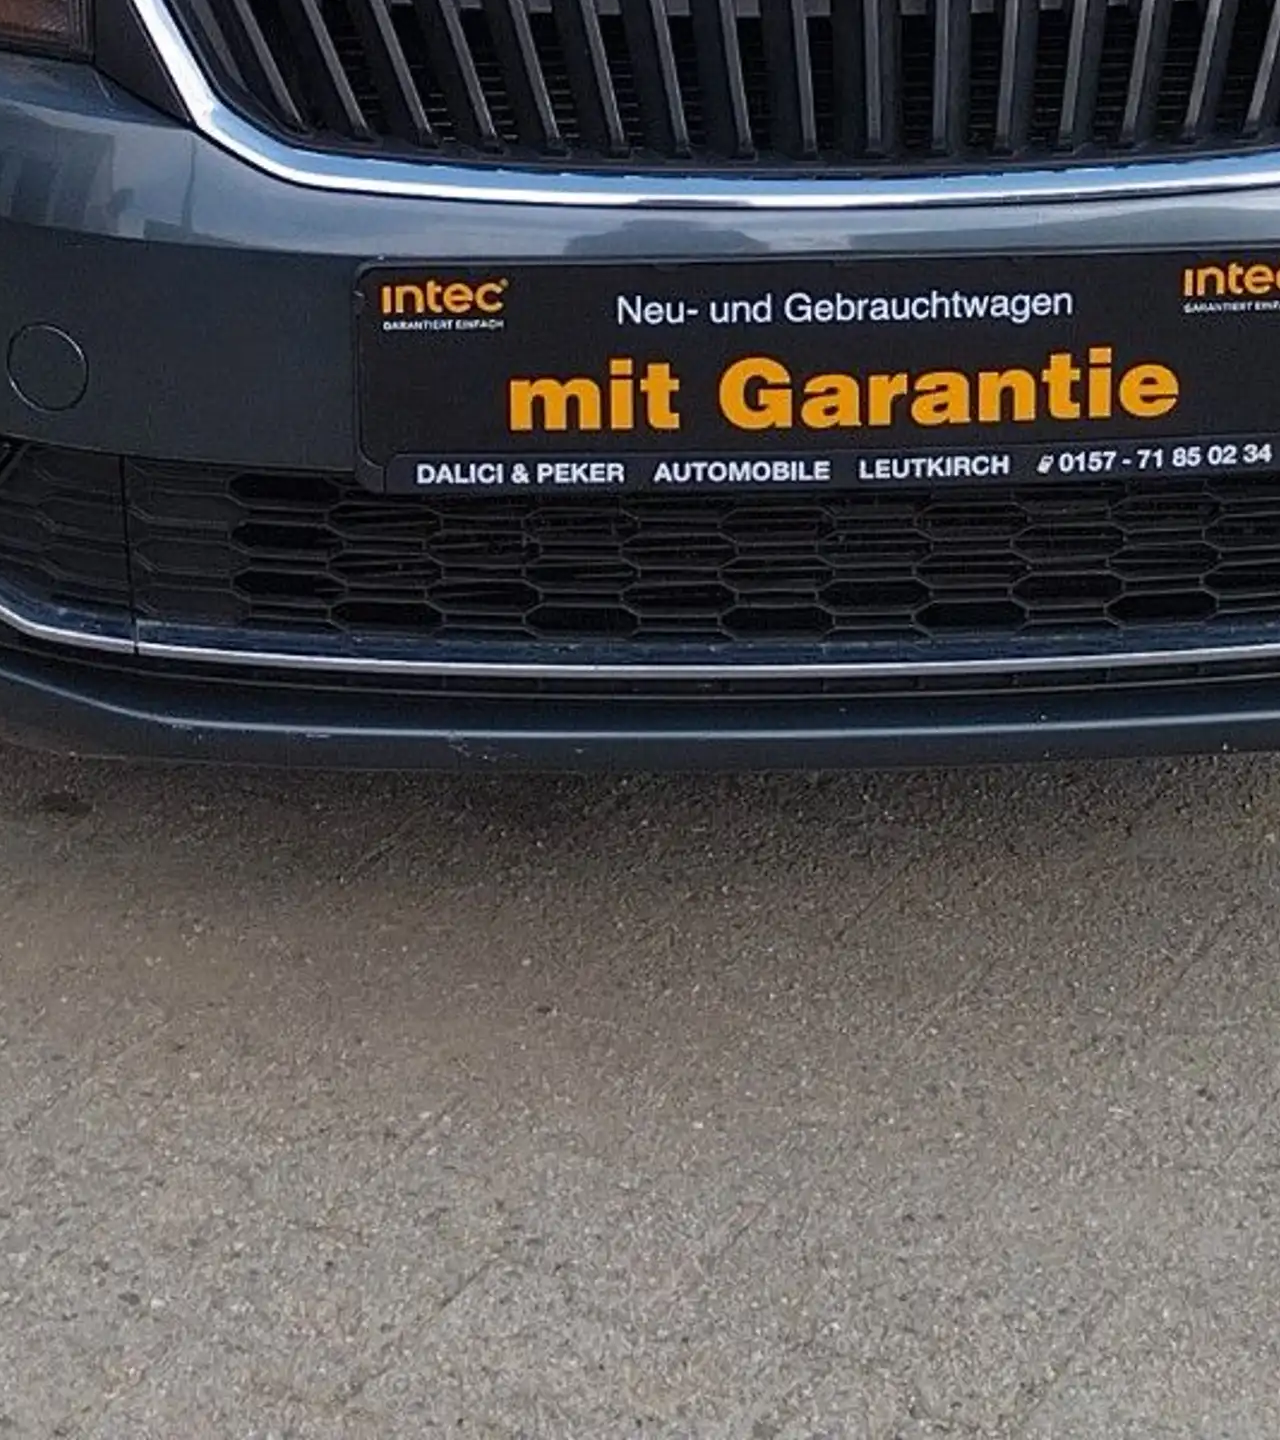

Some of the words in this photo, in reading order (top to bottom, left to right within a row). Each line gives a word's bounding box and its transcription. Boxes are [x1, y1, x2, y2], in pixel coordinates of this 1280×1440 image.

[616, 294, 698, 325] Neu-
[709, 293, 772, 324] und
[783, 290, 1074, 323] Gebrauchtwagen
[509, 358, 681, 431] mit
[719, 347, 1180, 431] Garantie
[416, 463, 504, 485] DALICI
[511, 463, 529, 484] &
[536, 462, 626, 483] PEKER
[653, 460, 831, 483] AUTOMOBILE
[858, 454, 1010, 480] LEUTKIRCH
[1058, 450, 1117, 473] 0157
[1137, 448, 1164, 470] 71
[1172, 446, 1201, 468] 85
[1207, 444, 1237, 467] 02
[1242, 443, 1272, 464] 34
